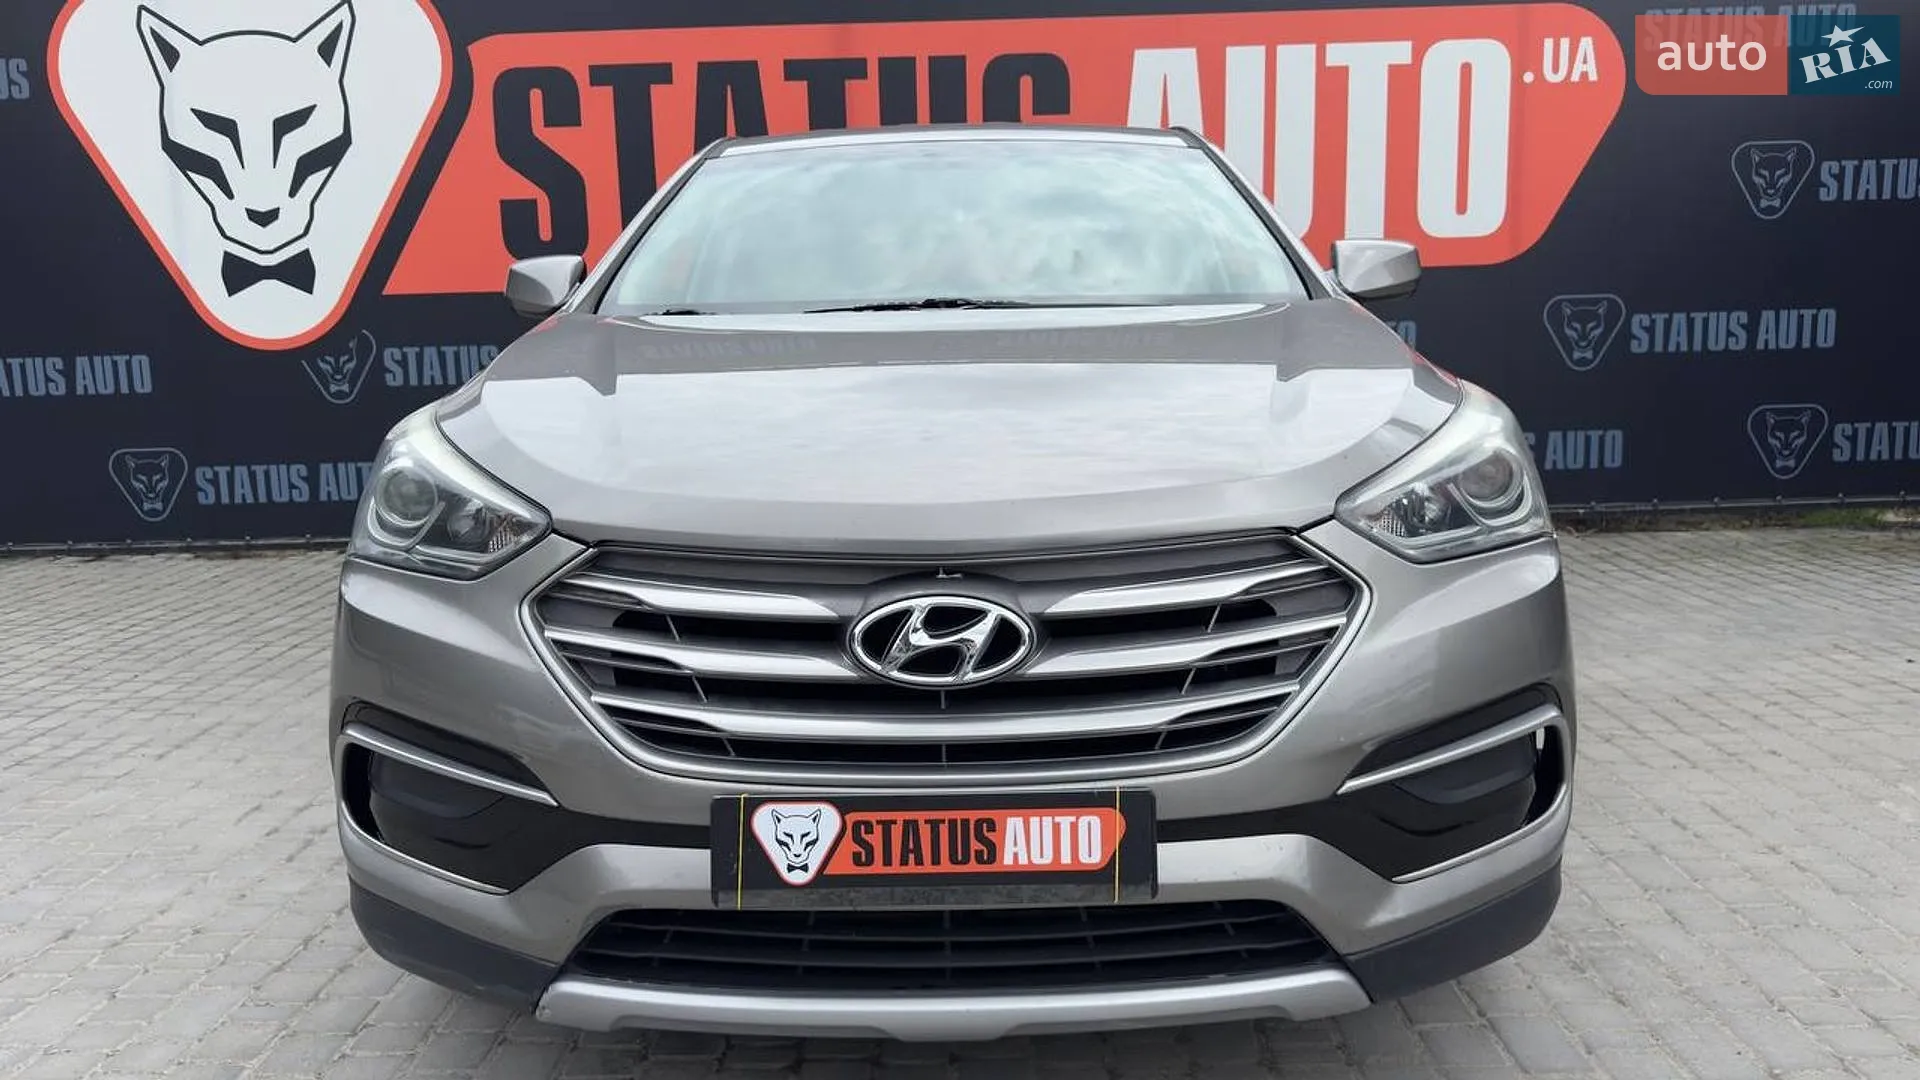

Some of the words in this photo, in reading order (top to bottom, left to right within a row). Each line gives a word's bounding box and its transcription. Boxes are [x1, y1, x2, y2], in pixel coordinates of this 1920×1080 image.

[1644, 6, 1765, 51] STATUS
[1819, 158, 1920, 201] STATU
[1630, 311, 1748, 353] STATUS
[1756, 309, 1836, 350] AUTO
[76, 355, 152, 395] AUTO
[1544, 430, 1623, 470] AUTO
[195, 464, 309, 504] STATUS
[852, 817, 997, 867] STATUS
[1003, 815, 1102, 866] AUTO
